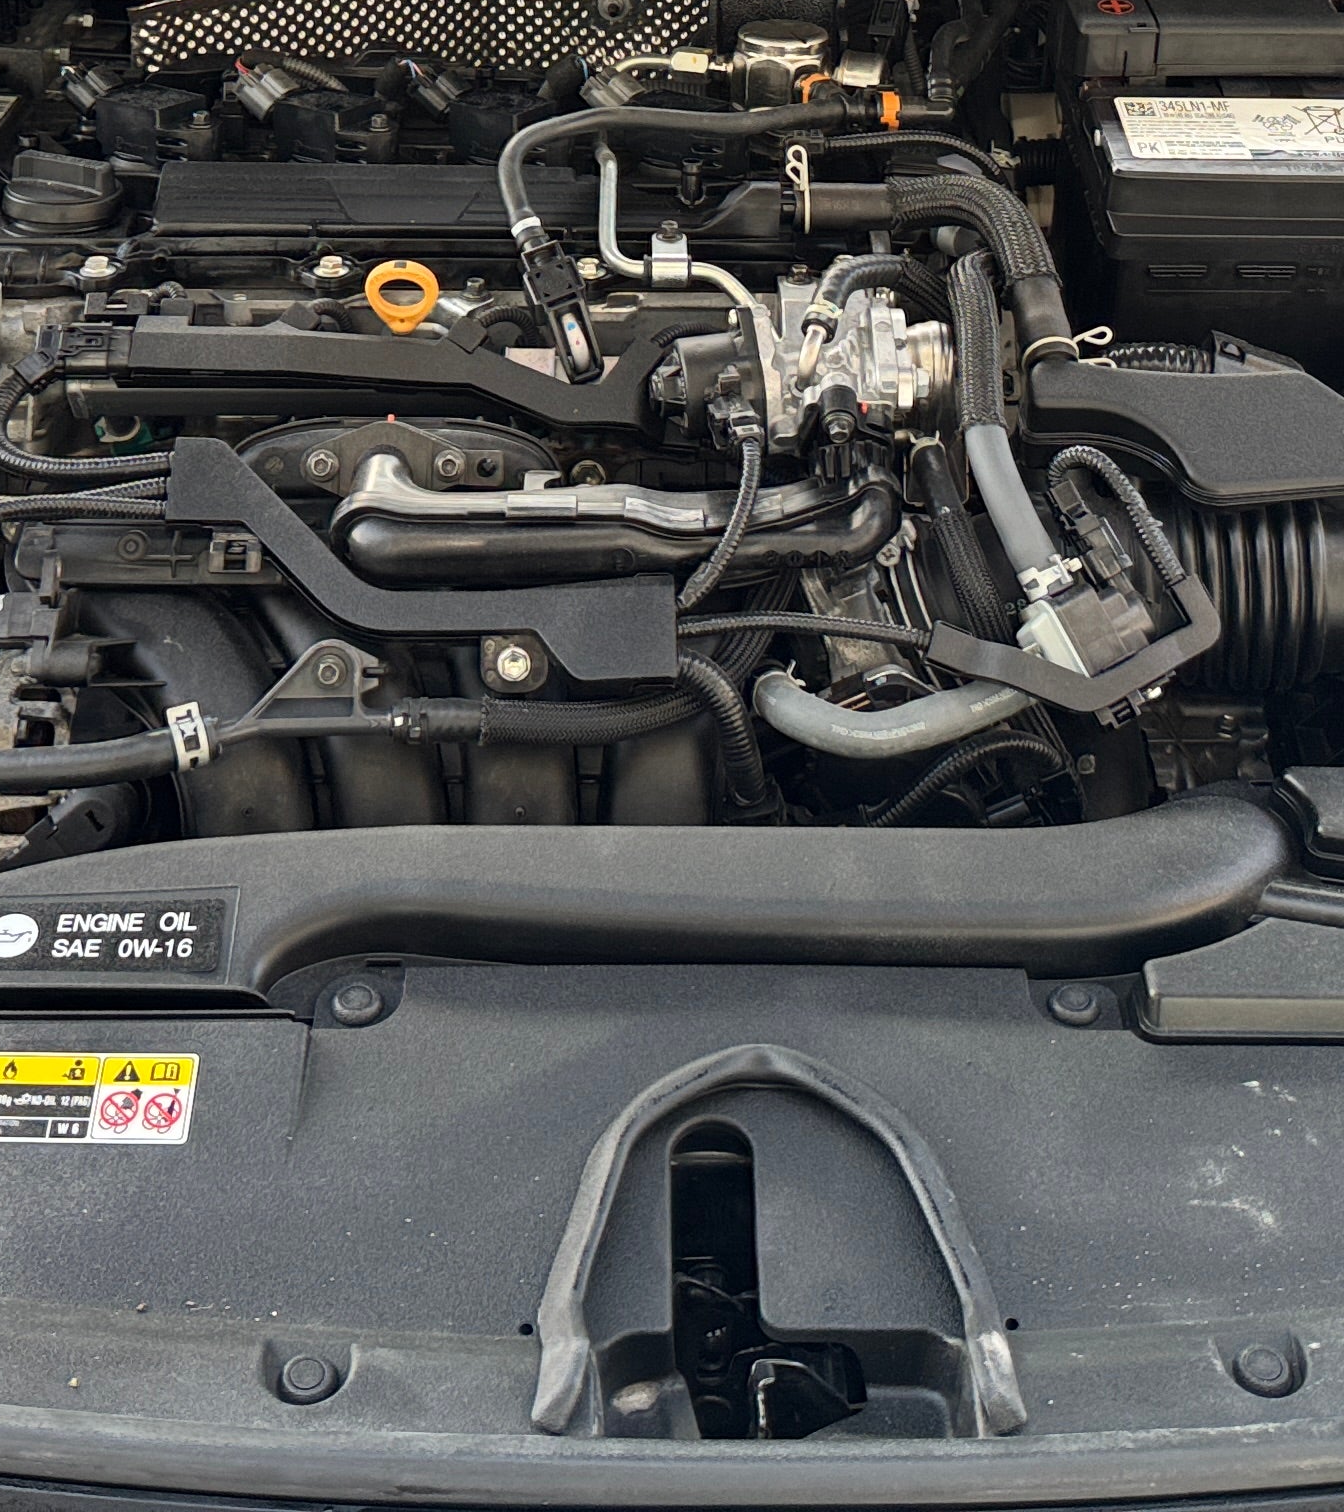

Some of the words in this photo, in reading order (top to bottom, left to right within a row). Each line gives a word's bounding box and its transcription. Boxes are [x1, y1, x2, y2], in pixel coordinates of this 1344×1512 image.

[56, 912, 145, 933] ENGINE
[159, 911, 197, 932] OIL
[51, 938, 102, 958] SAE
[117, 937, 194, 958] 0W-16
